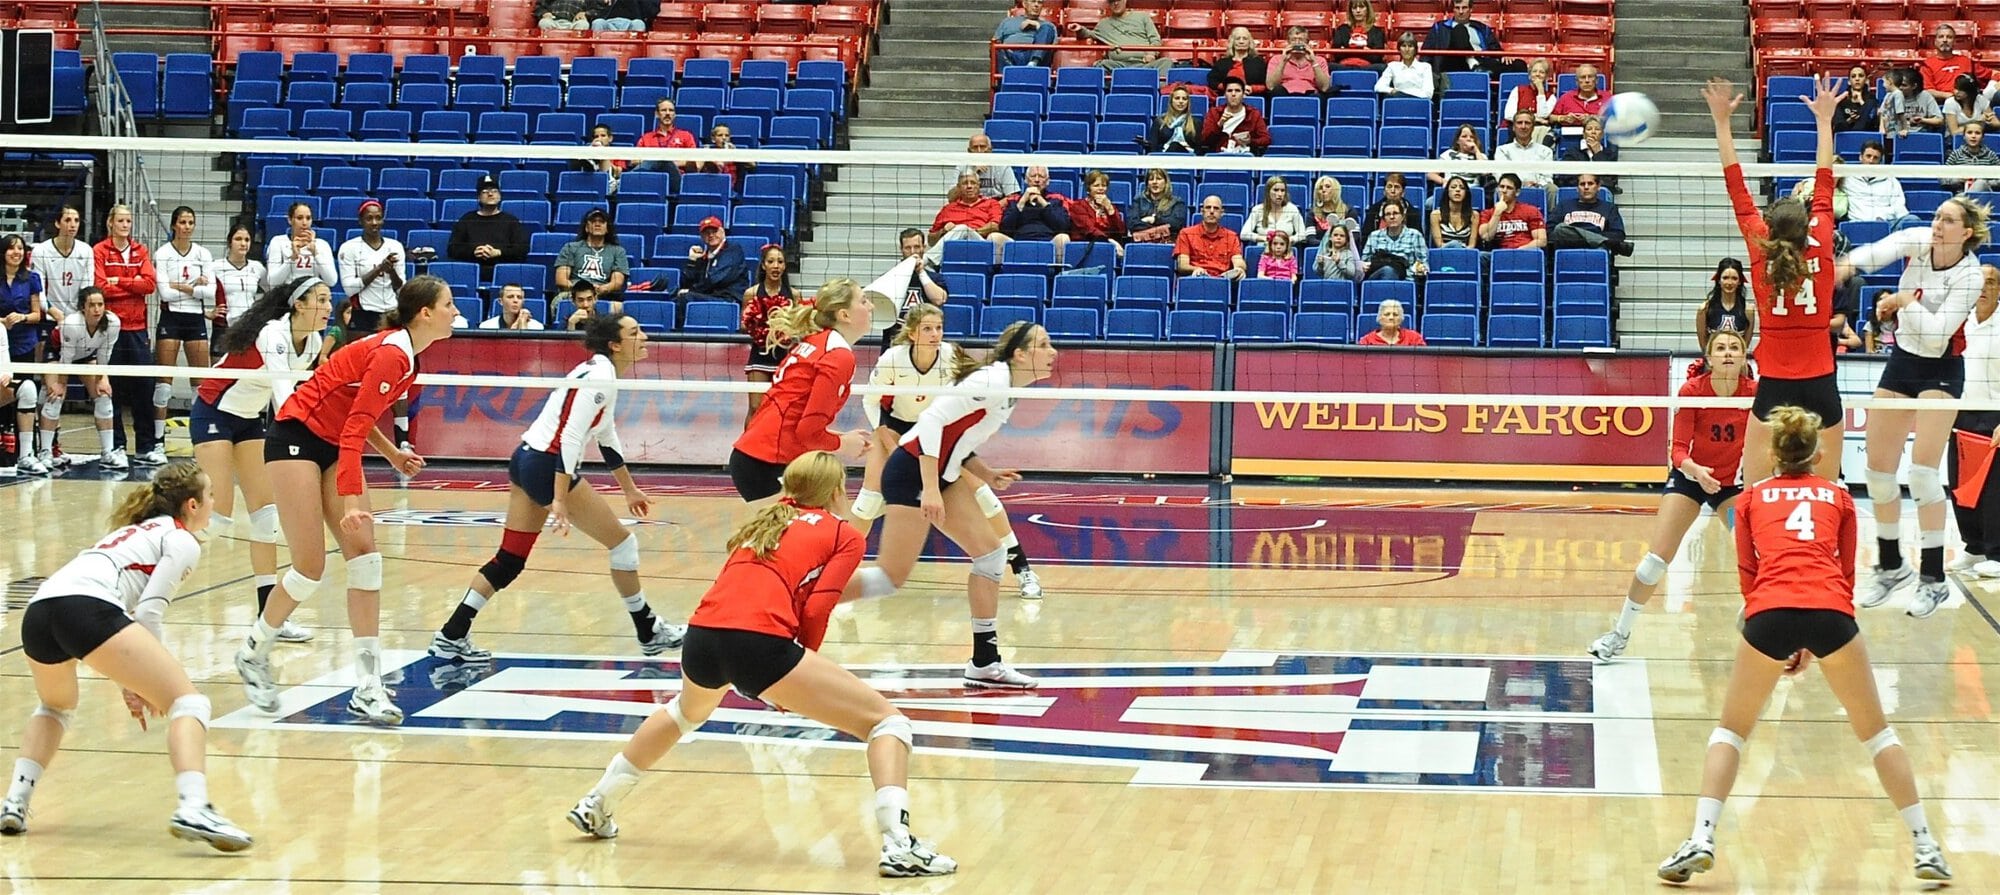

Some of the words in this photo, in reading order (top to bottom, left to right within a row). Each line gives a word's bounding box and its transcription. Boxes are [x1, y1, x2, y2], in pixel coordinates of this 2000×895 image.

[1496, 221, 1529, 234] RIZONA
[296, 255, 313, 269] 22
[578, 254, 607, 280] A
[62, 272, 74, 287] 12
[182, 266, 190, 280] 4
[1772, 277, 1818, 316] 14
[1255, 401, 1448, 433] WELLS
[1462, 404, 1654, 436] FARGO
[1710, 423, 1735, 443] 33
[1761, 486, 1835, 505] UTAH
[1784, 501, 1816, 541] 4
